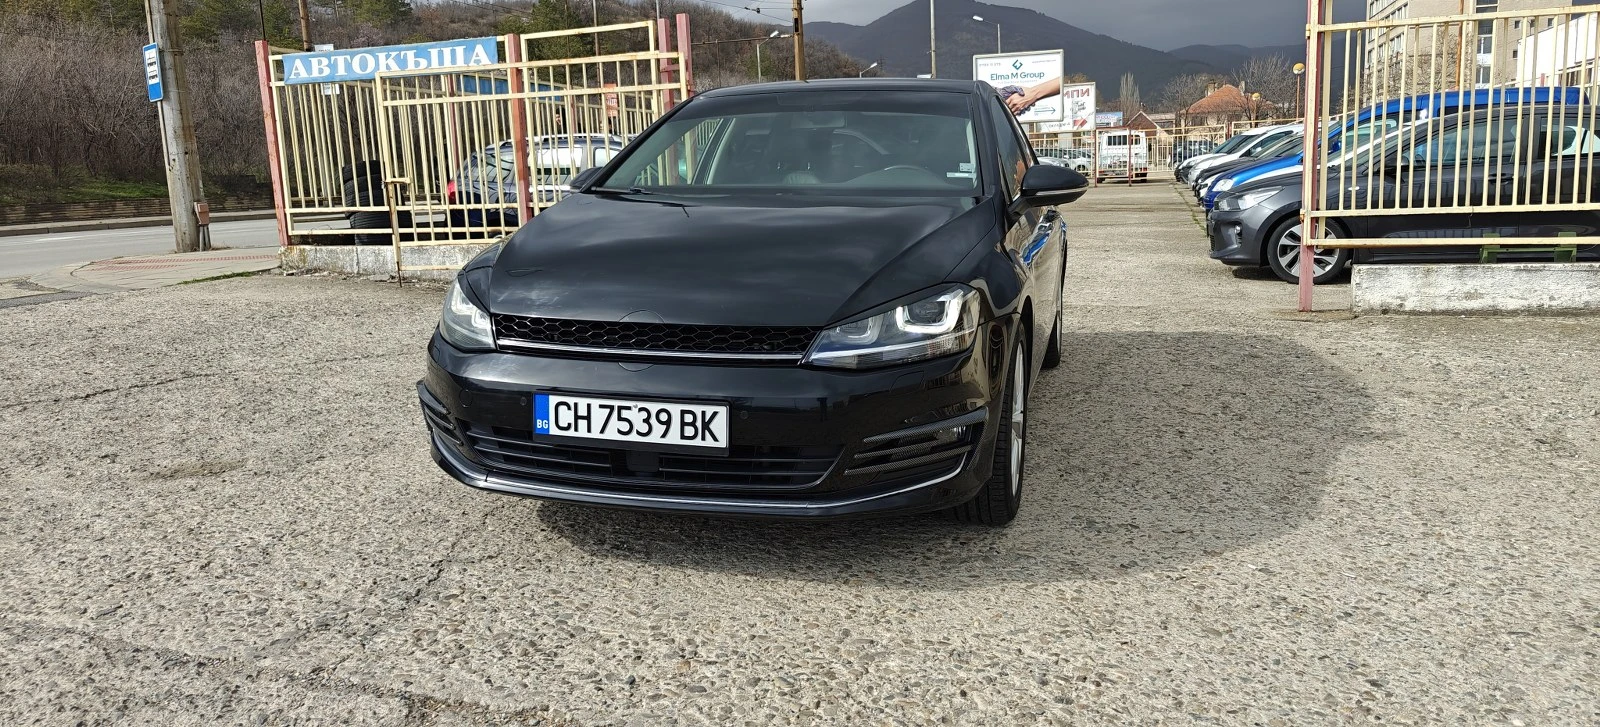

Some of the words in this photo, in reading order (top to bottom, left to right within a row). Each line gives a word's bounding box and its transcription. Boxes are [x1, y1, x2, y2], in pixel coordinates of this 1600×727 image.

[990, 73, 1009, 81] Elma
[1020, 71, 1045, 80] Group
[536, 419, 549, 429] BG
[554, 401, 592, 434] CH
[598, 404, 672, 439] 7539
[679, 409, 720, 442] BK
